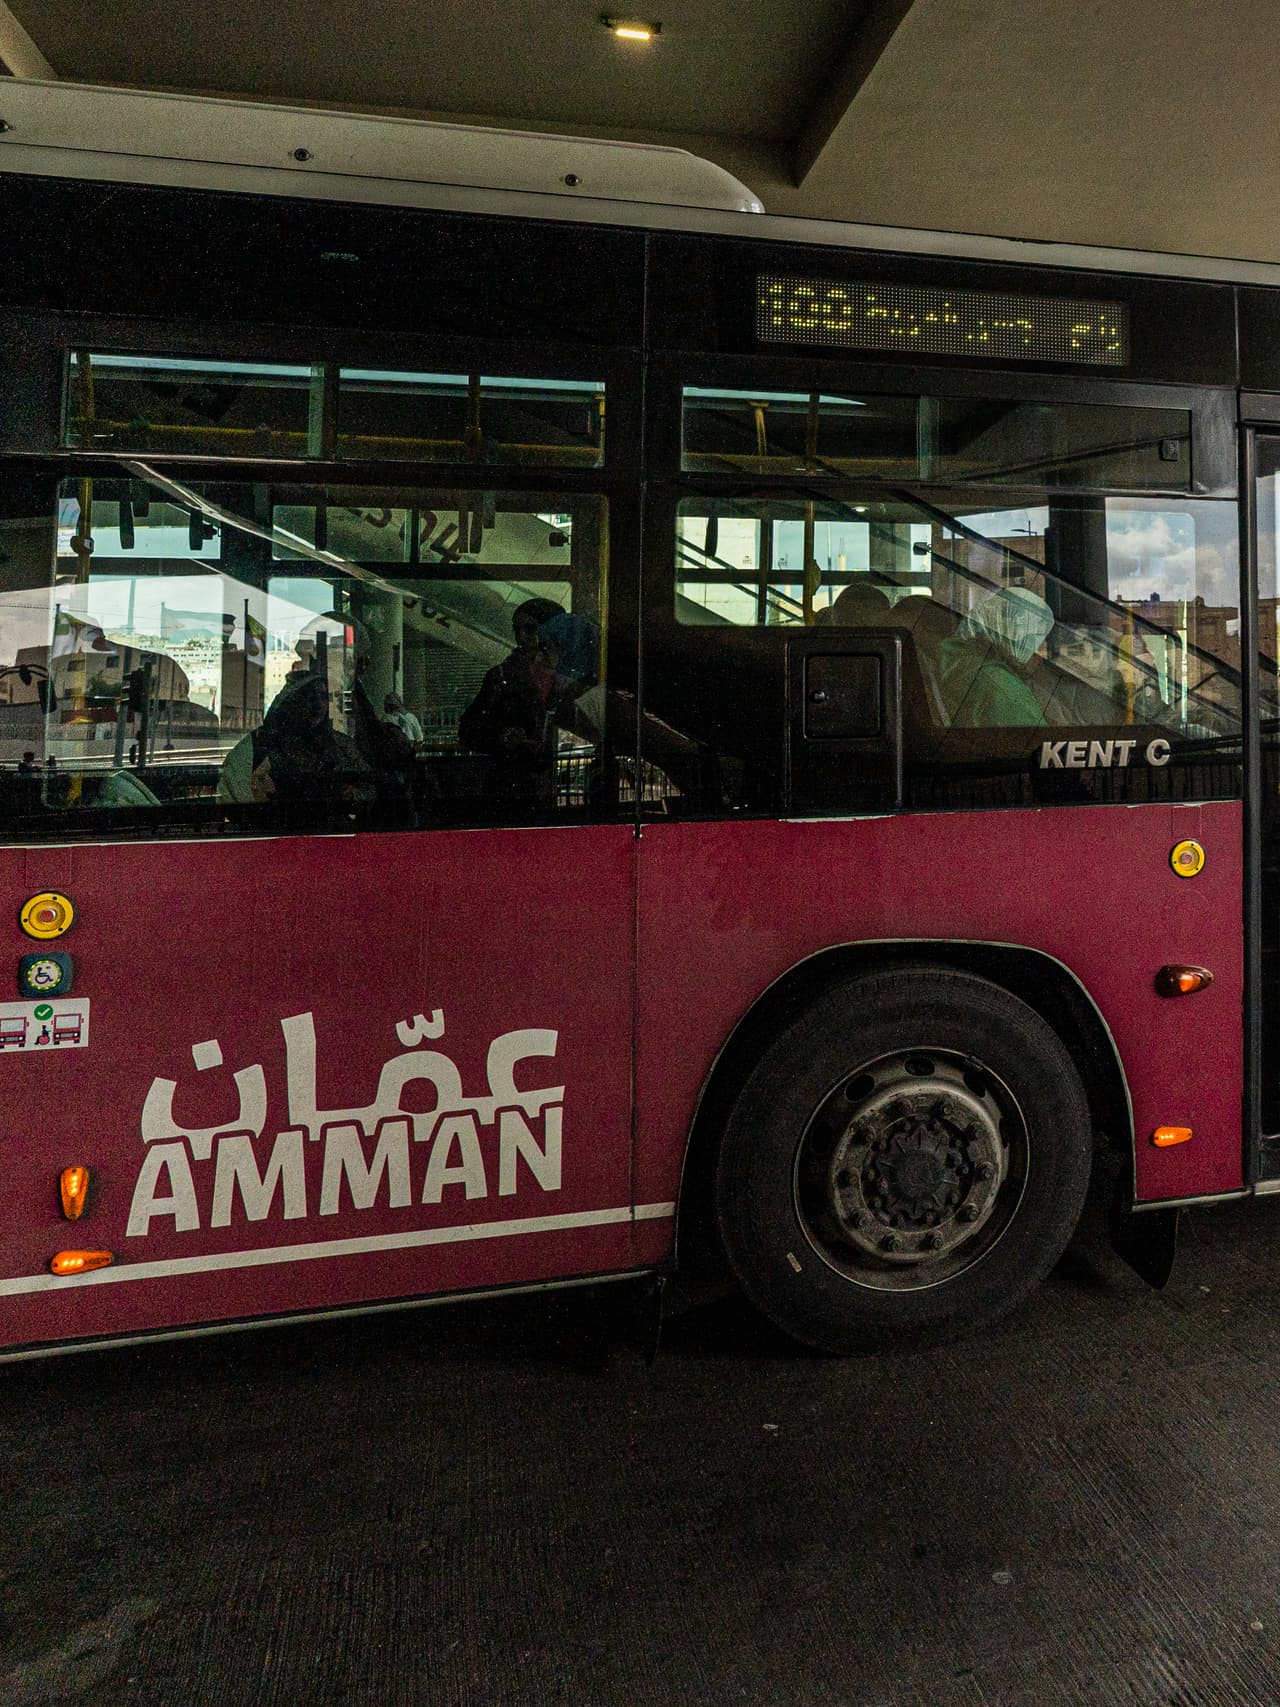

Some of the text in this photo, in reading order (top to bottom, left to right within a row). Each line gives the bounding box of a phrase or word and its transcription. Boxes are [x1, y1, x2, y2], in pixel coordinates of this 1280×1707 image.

[1040, 738, 1171, 769] KENT C
[126, 1106, 564, 1237] AMMAN
